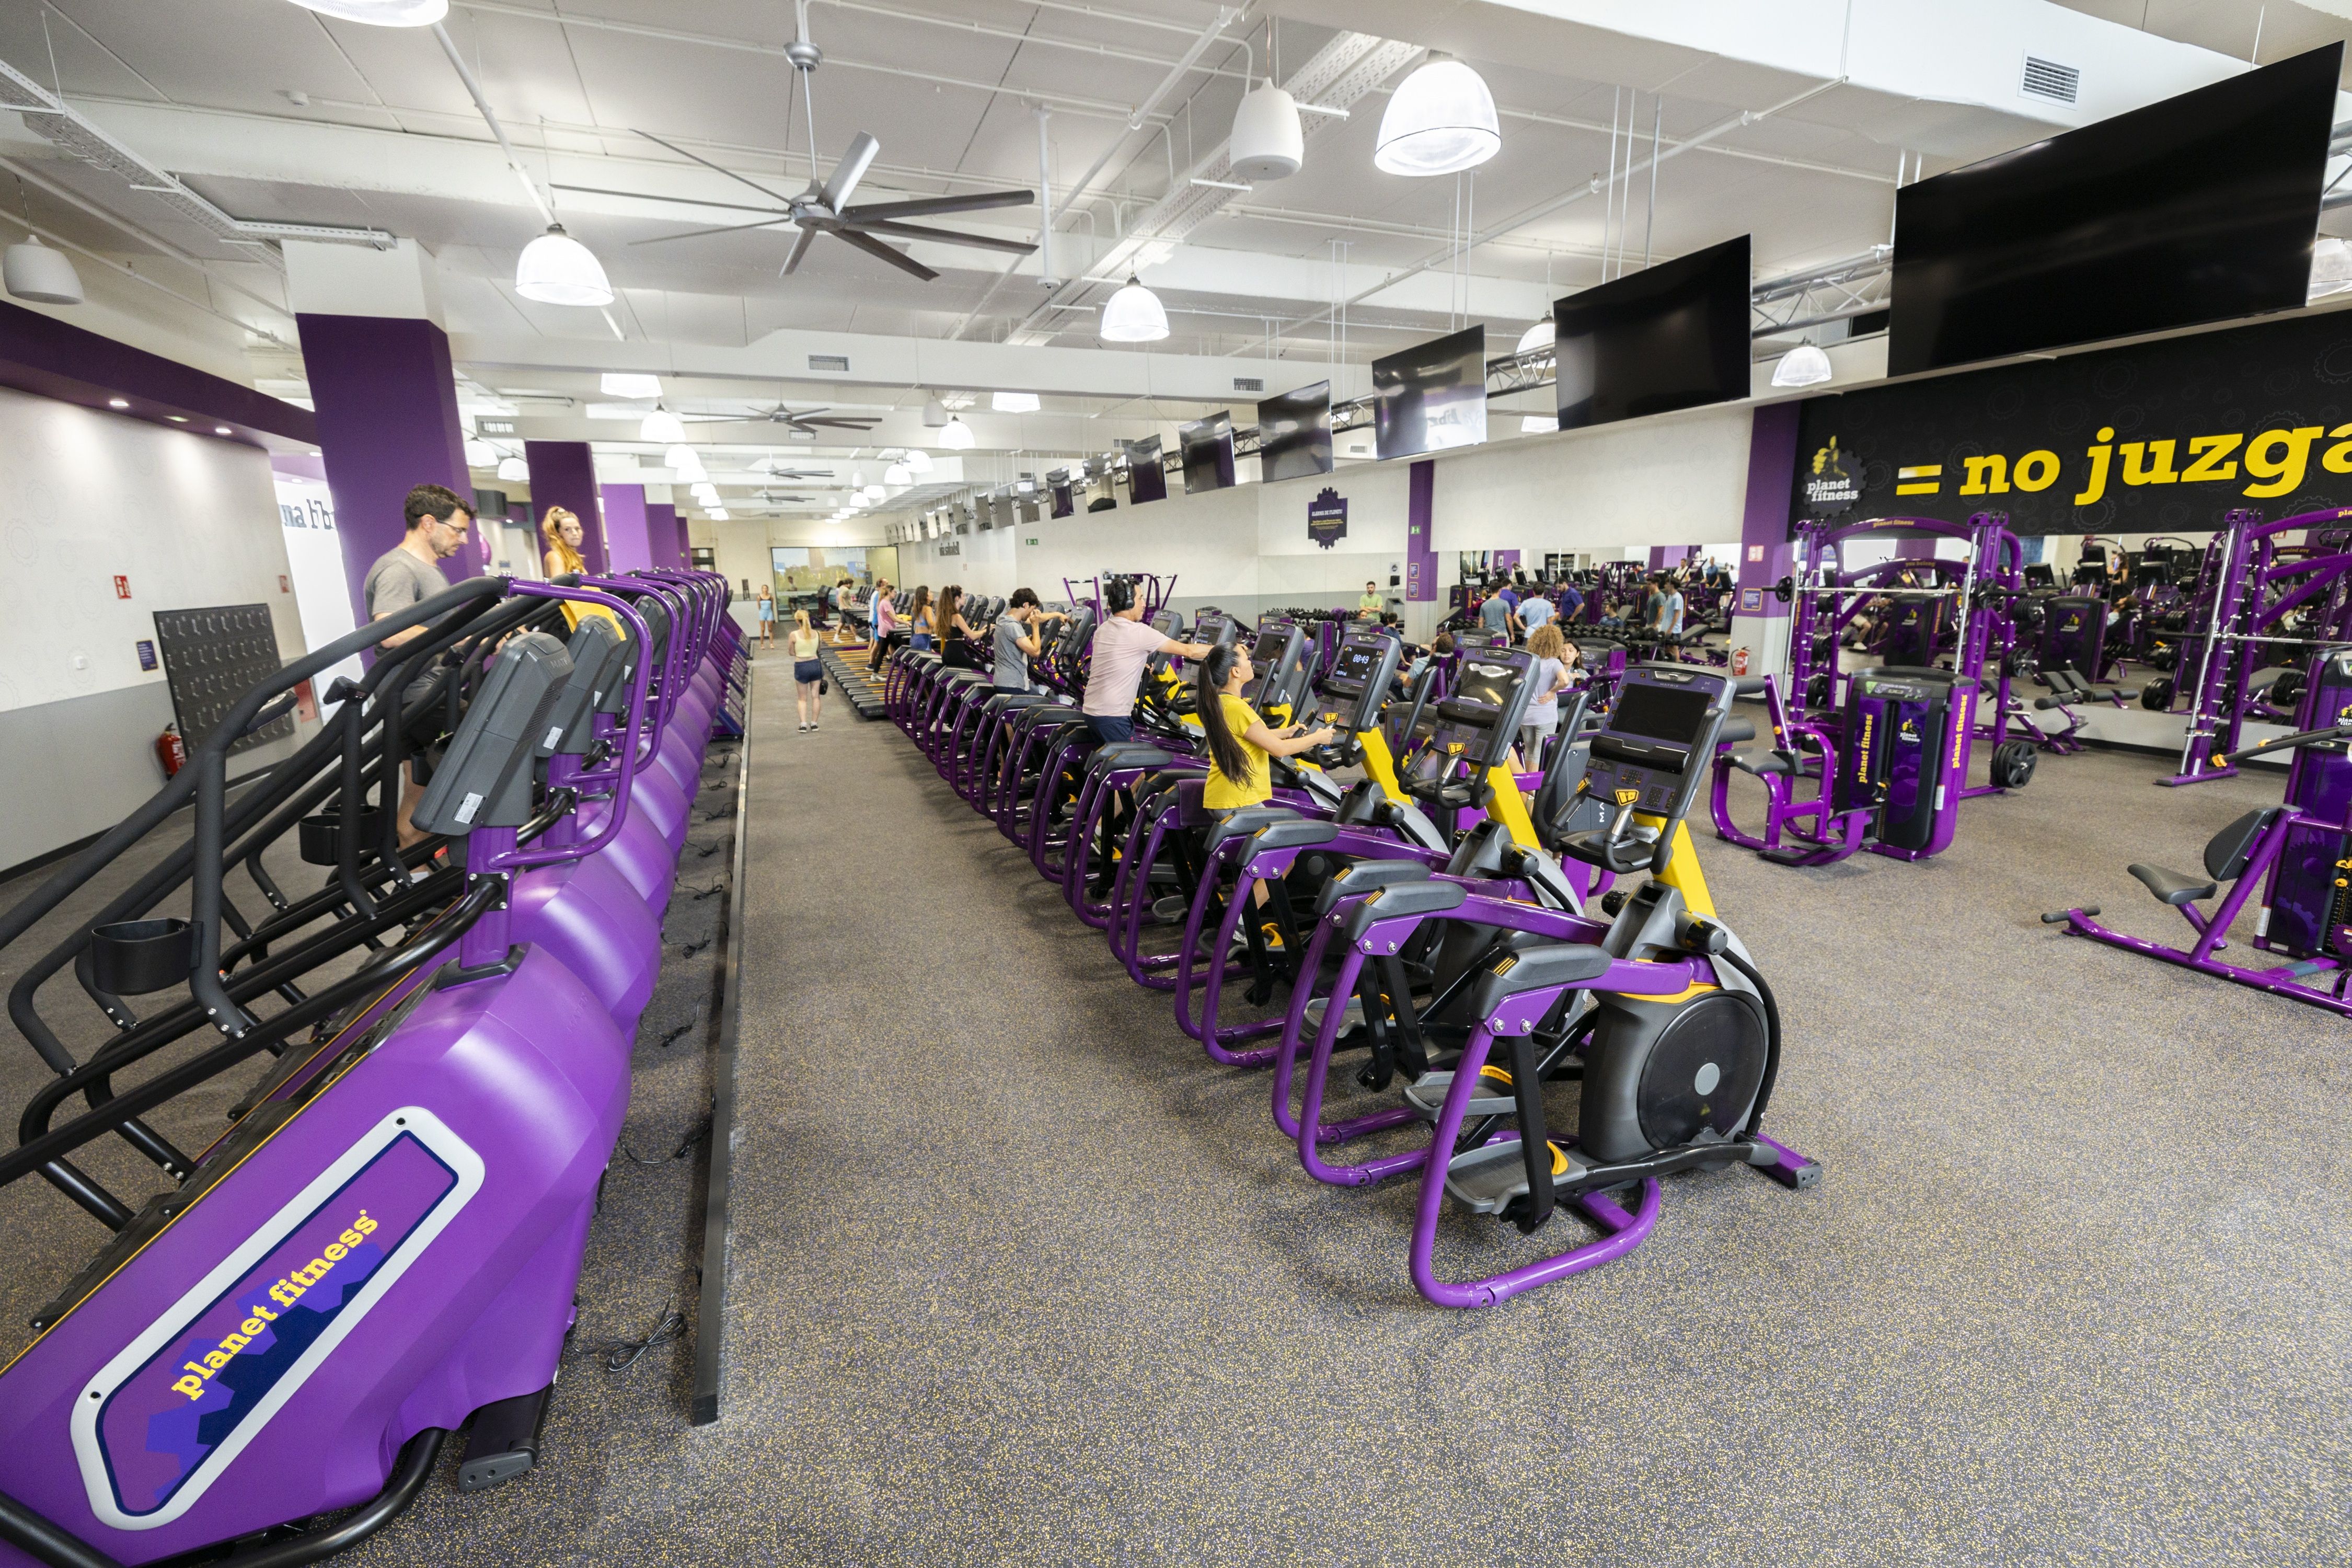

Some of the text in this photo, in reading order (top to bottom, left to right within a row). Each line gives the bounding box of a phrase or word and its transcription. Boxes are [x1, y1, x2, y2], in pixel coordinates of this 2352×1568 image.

[1806, 478, 1851, 494] planet
[1959, 450, 2060, 495] no
[1811, 490, 1859, 502] fitness
[1353, 654, 1369, 664] 00:49
[1858, 714, 1873, 783] planet fitness
[1952, 695, 1967, 768] planet fitness
[171, 1212, 378, 1401] planet fitness
